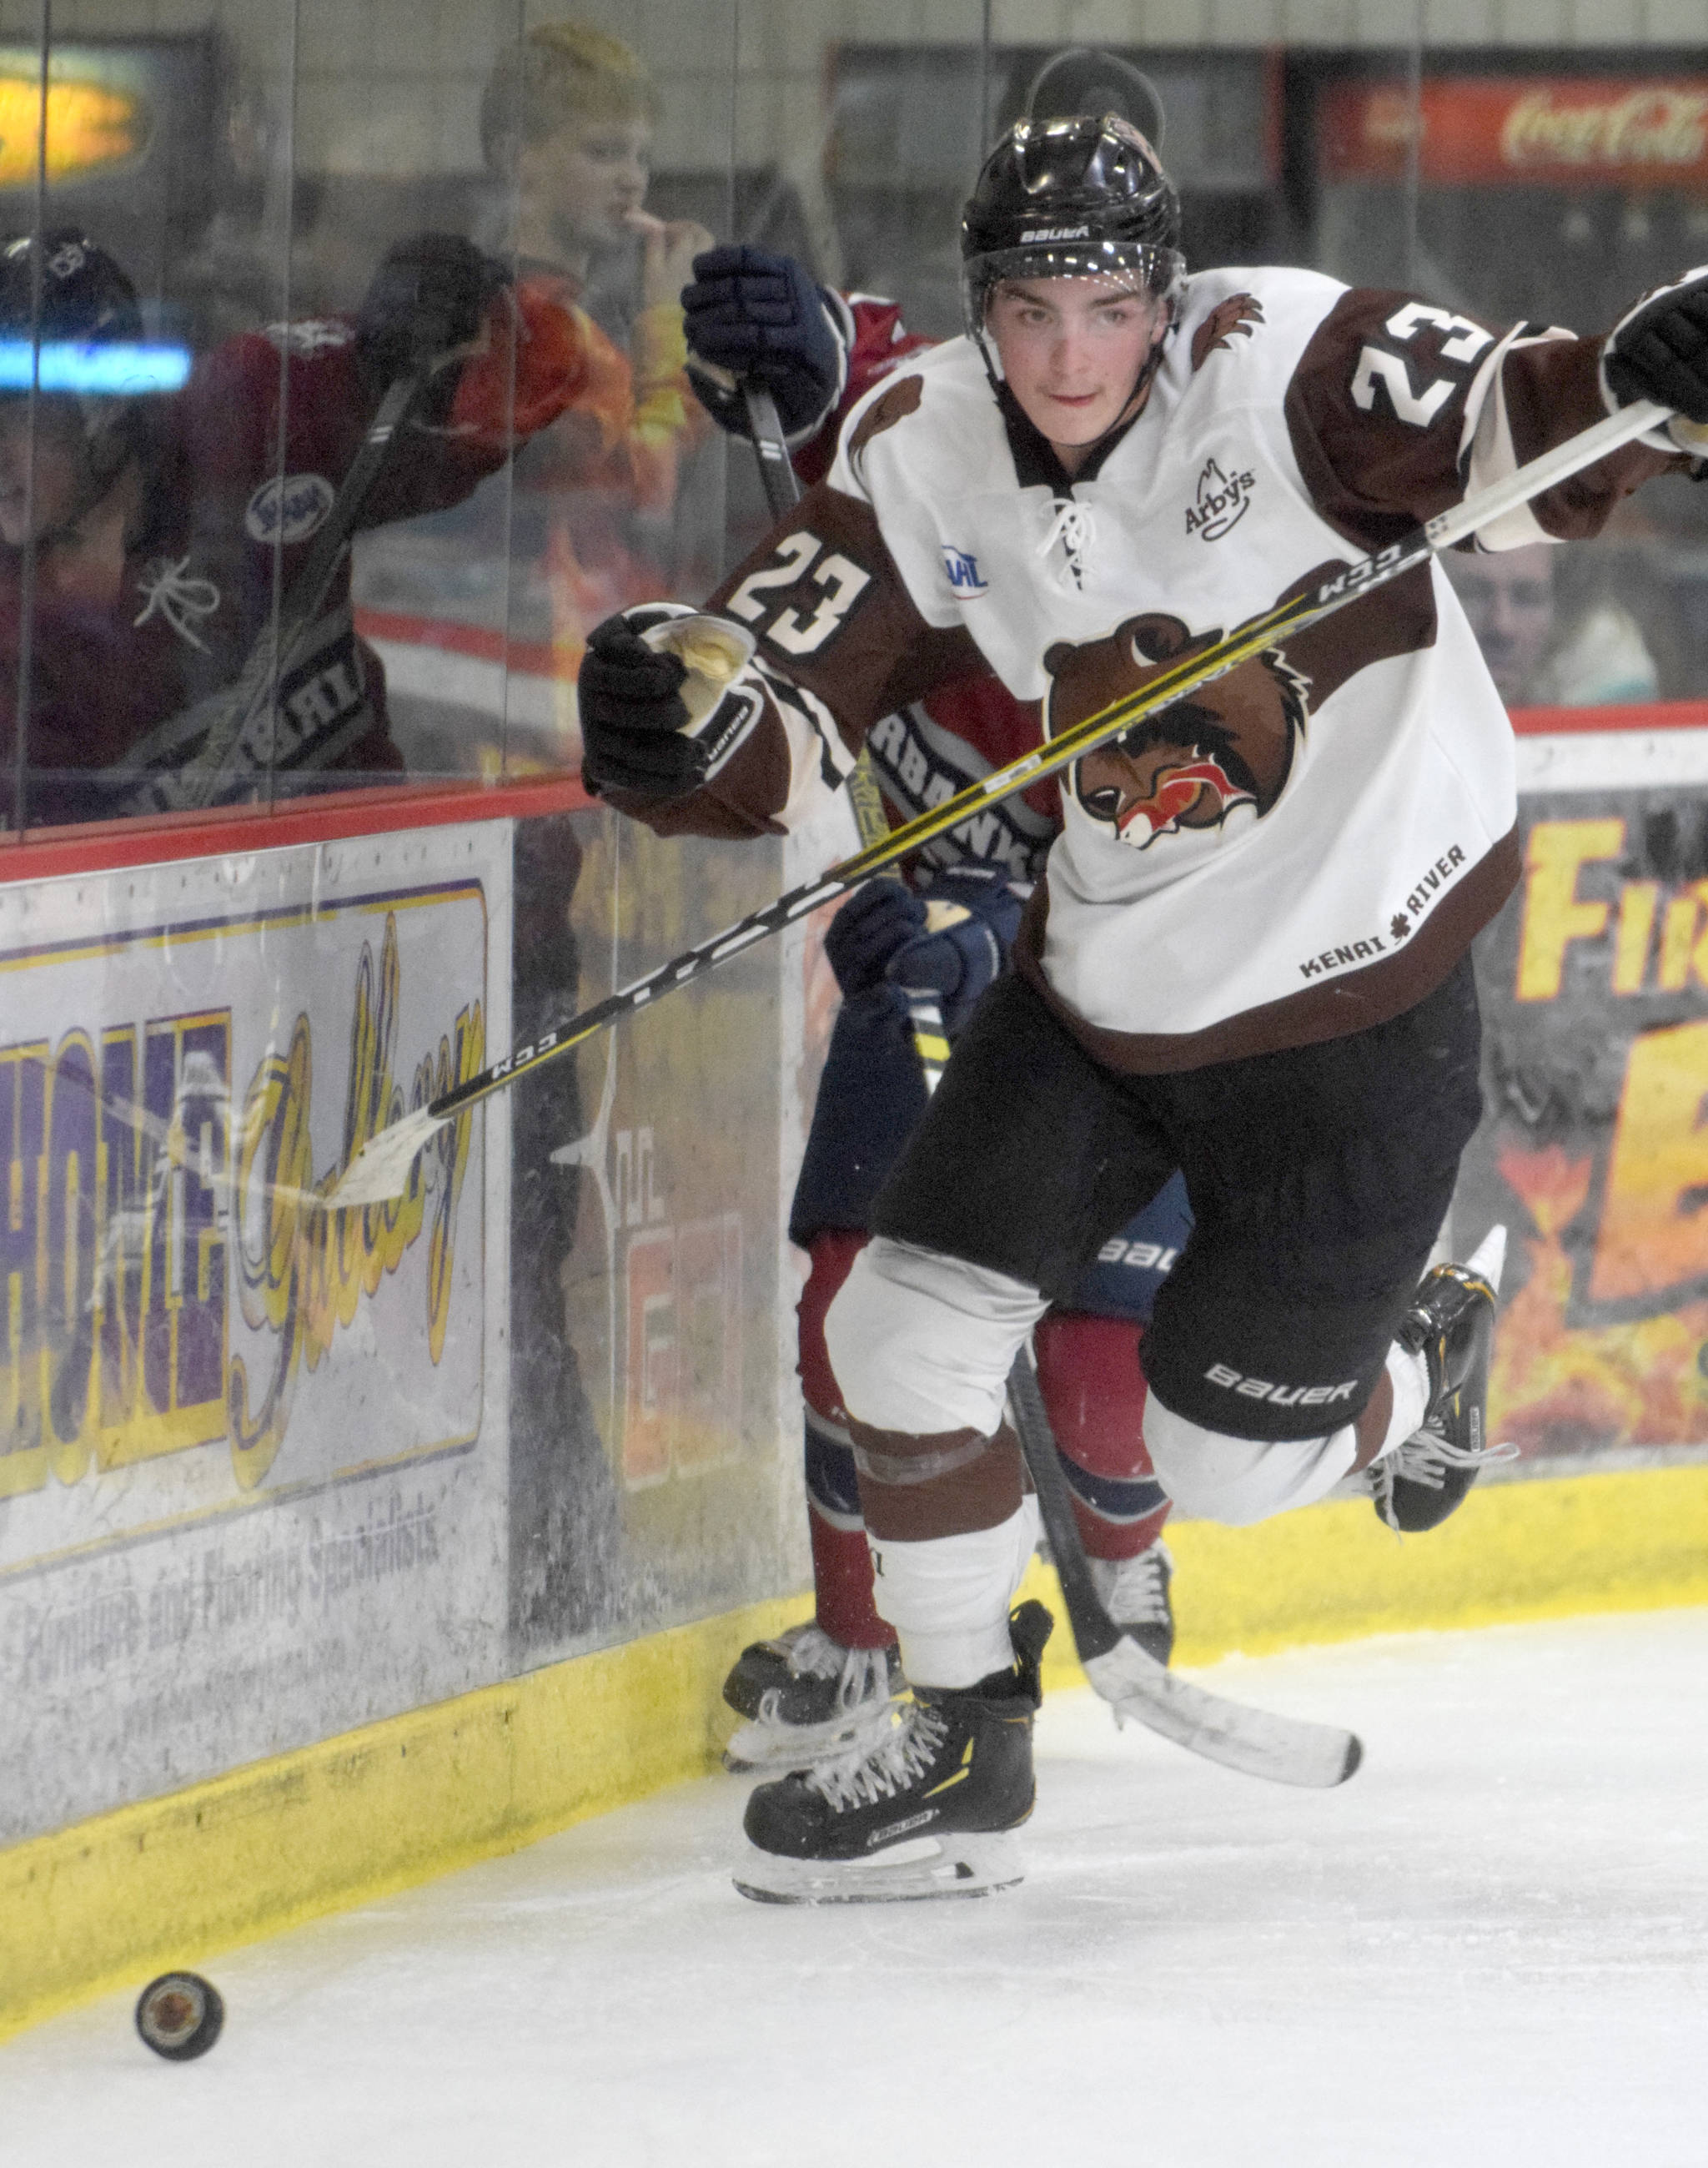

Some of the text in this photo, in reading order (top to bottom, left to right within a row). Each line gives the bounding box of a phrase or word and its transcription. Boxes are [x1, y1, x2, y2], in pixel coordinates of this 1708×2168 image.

[1019, 225, 1090, 244] BAUER
[1350, 302, 1495, 428] 23
[1184, 470, 1256, 535] Arby's
[726, 531, 872, 655] 23
[1319, 544, 1402, 602] CCM
[1299, 843, 1467, 978] KENAI RIVER
[491, 1032, 557, 1079] CCM
[1204, 1363, 1359, 1406] BAUER
